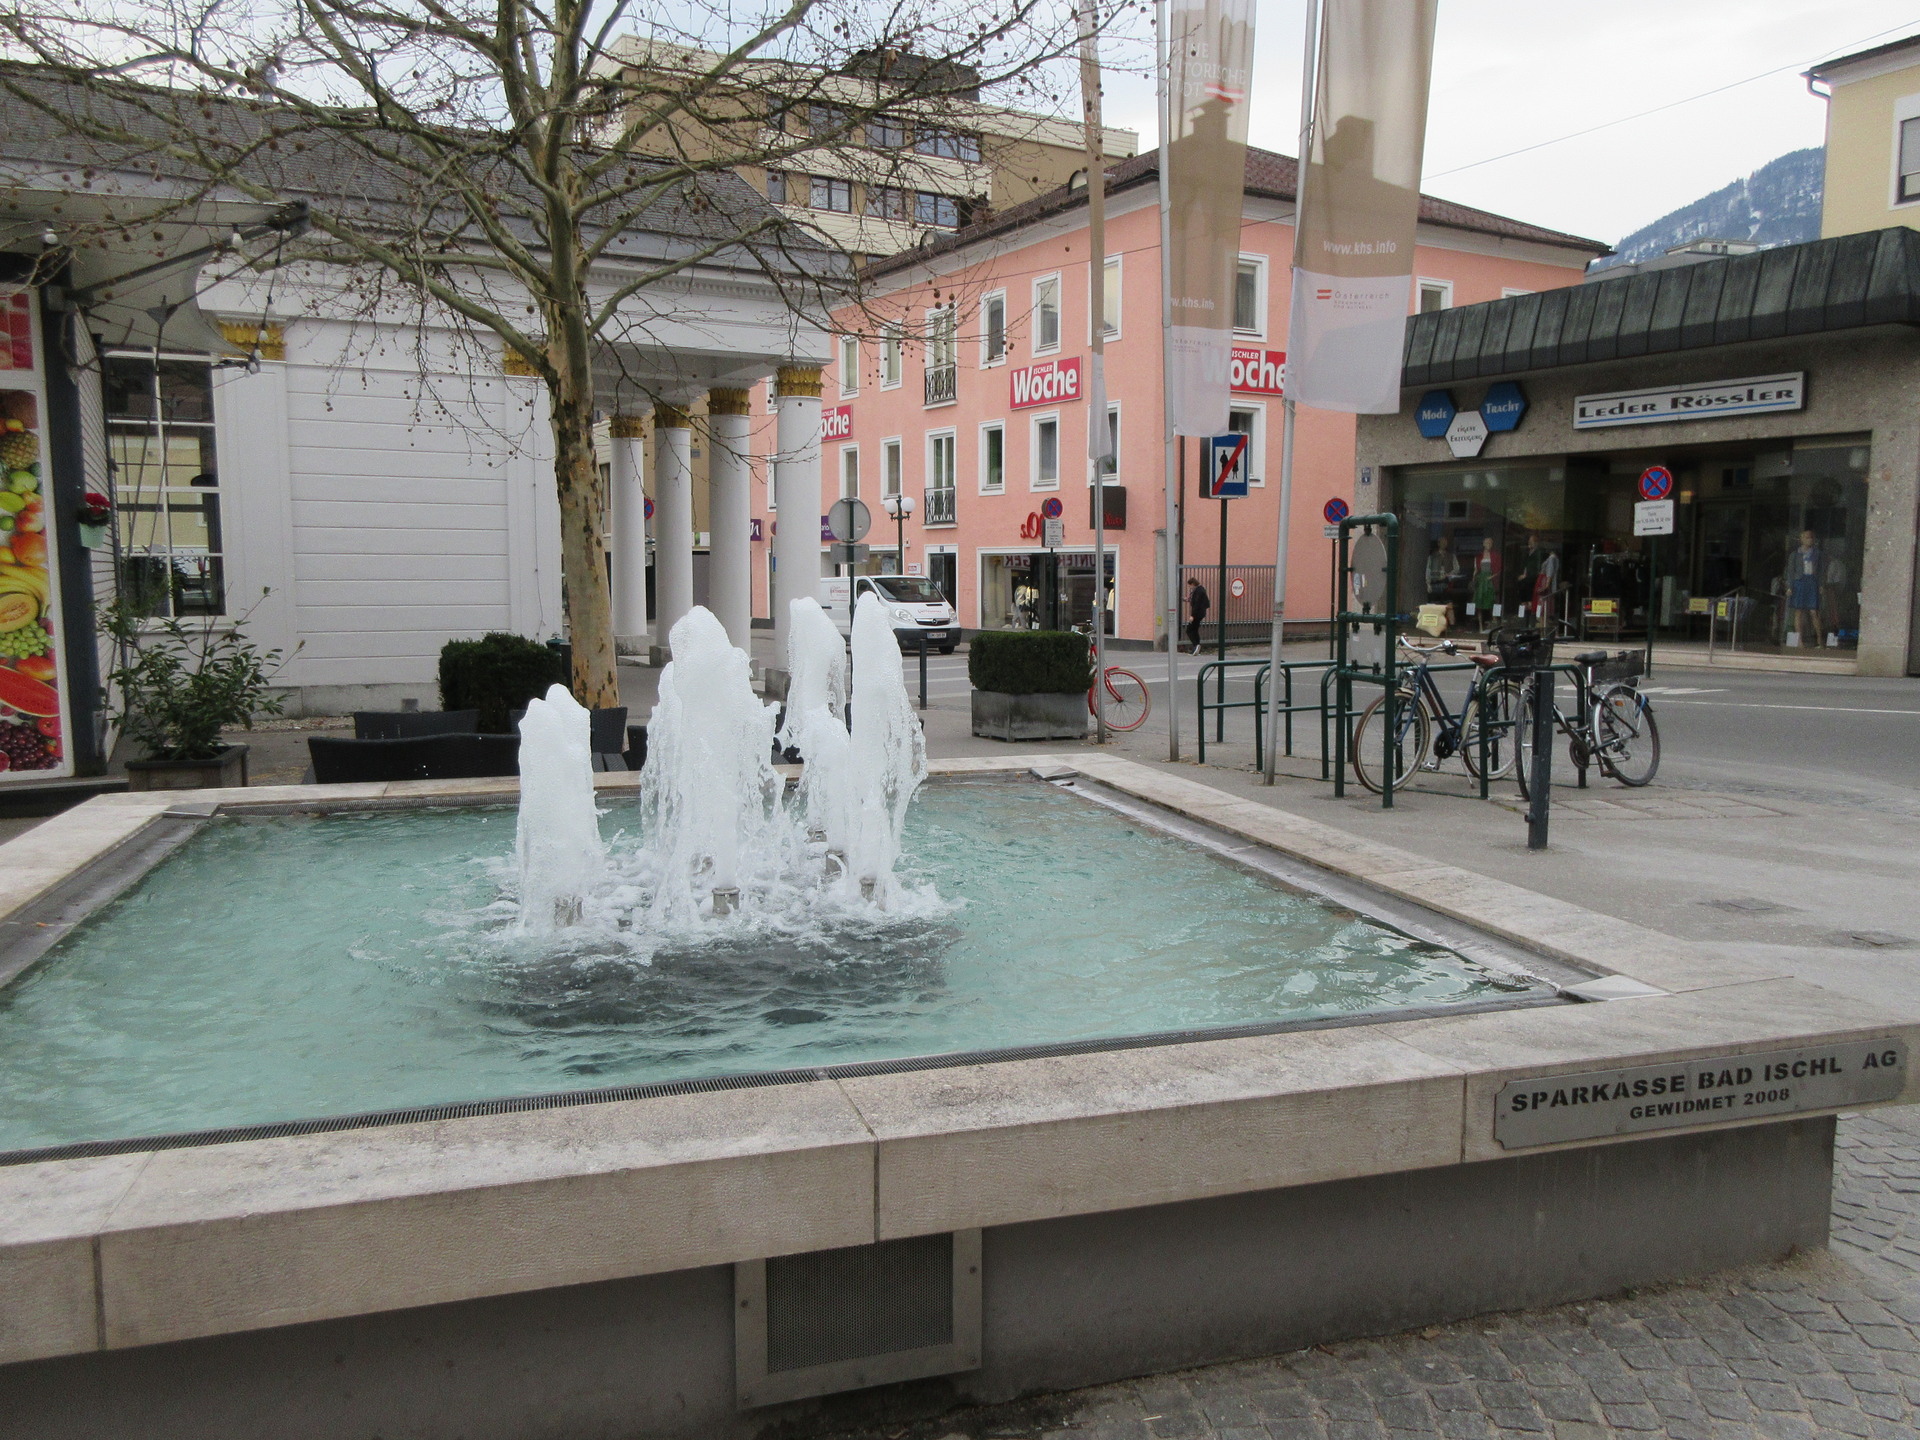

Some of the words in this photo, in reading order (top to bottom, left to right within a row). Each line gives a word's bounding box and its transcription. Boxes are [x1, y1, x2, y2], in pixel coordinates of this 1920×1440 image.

[1323, 240, 1397, 255] www.khs.info
[1013, 360, 1078, 404] Woche
[1578, 402, 1657, 418] Leder
[1670, 388, 1794, 409] Rössler
[820, 407, 850, 437] oche
[1511, 1075, 1685, 1112] SPARKASSE
[1698, 1067, 1752, 1089] BAD
[1764, 1057, 1842, 1081] ISCHL
[1862, 1050, 1896, 1069] AG
[1630, 1095, 1736, 1119] GEWIDMET
[1743, 1088, 1790, 1105] 2008
